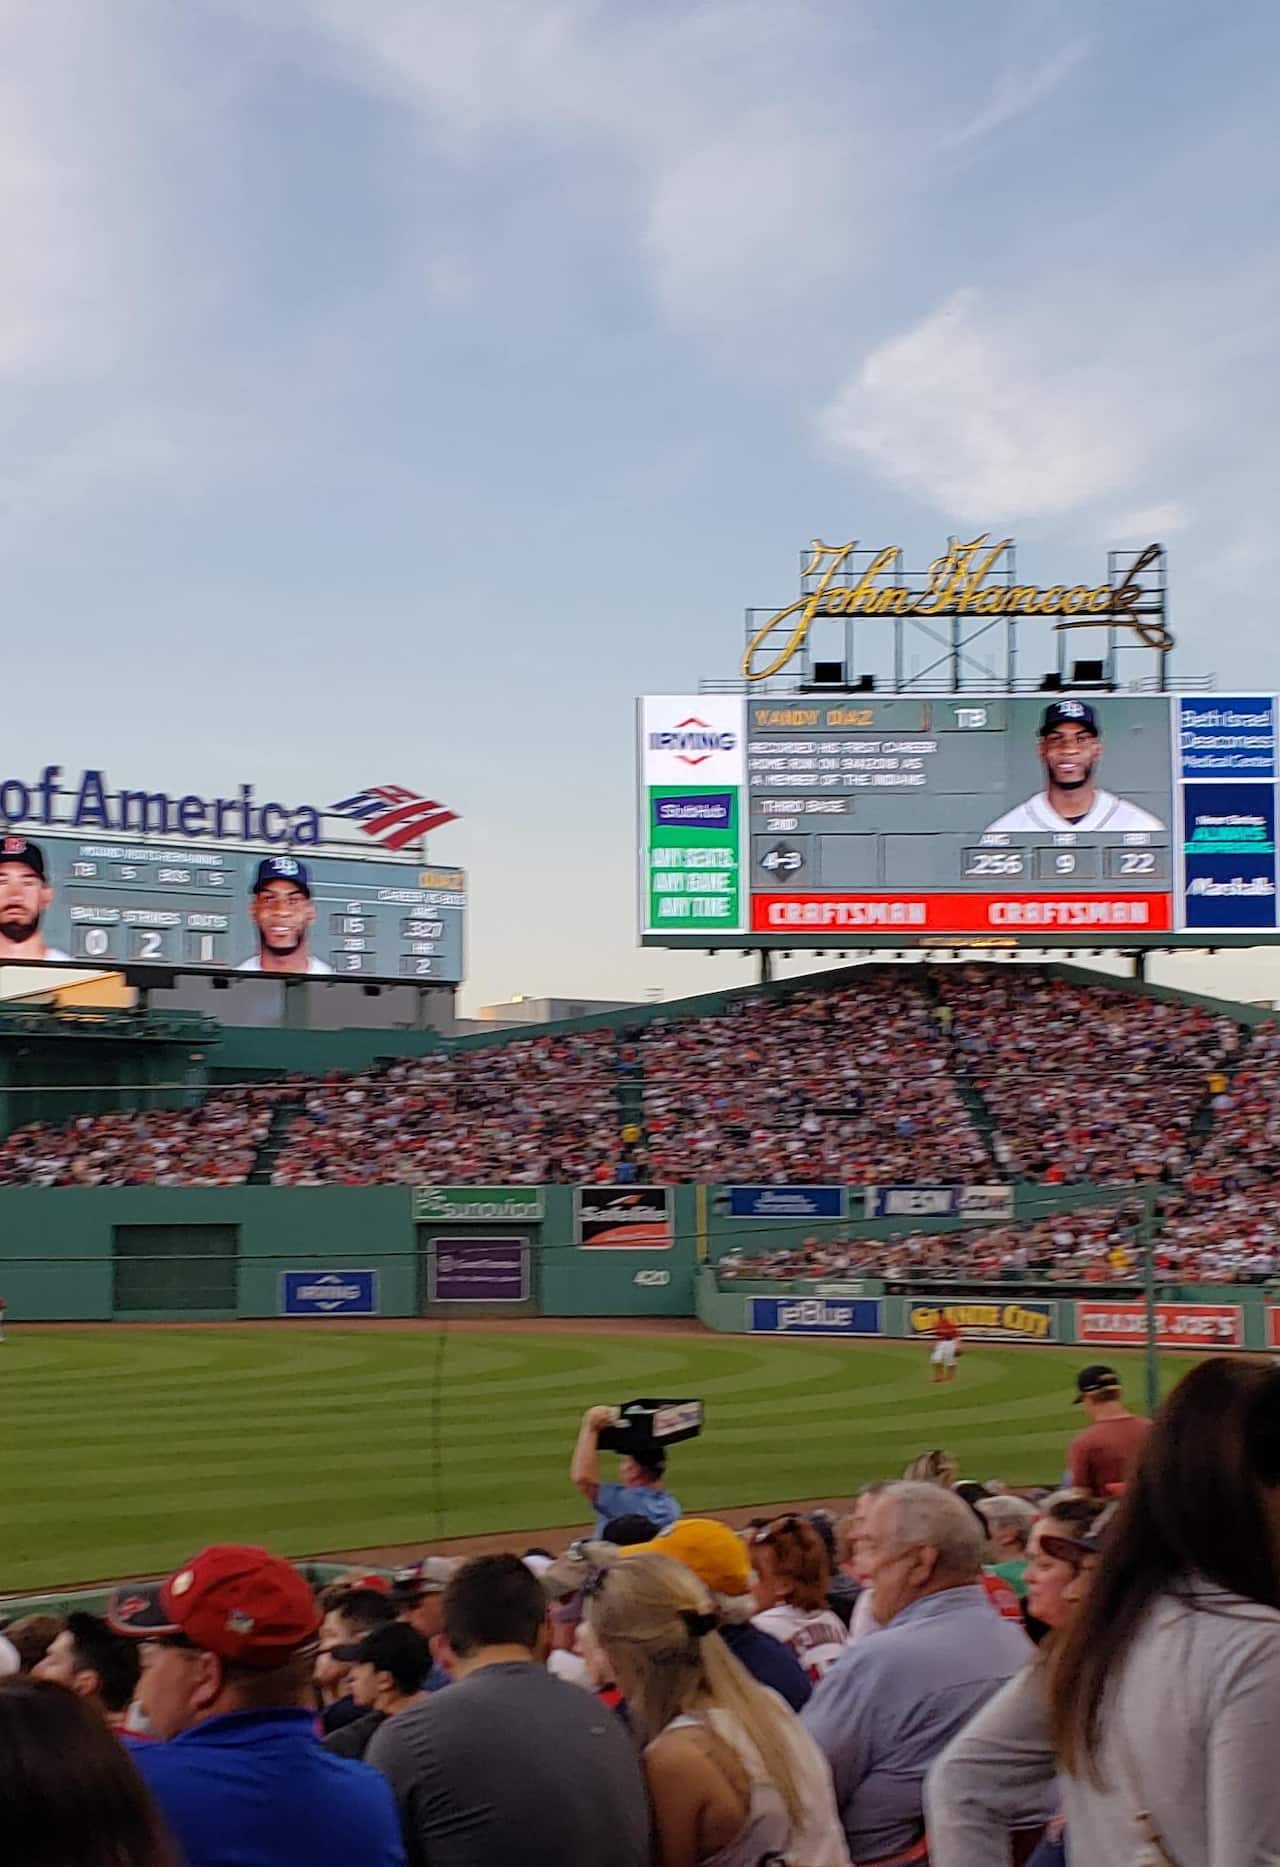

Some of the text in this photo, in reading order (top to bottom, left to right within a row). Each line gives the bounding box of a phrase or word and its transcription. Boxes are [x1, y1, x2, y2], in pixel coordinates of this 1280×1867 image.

[742, 533, 1174, 680] John Hancock
[754, 709, 875, 726] YANDY DIAZ
[954, 708, 987, 728] TB
[648, 731, 736, 751] IRVING
[72, 768, 326, 845] America
[760, 851, 802, 870] 4-3
[1055, 854, 1076, 875] 9
[1120, 853, 1156, 874] 22
[209, 872, 225, 886] 5
[70, 906, 228, 928] BALLS STRIKES OUTS
[768, 902, 926, 925] CRAFTSMAN
[988, 901, 1150, 924] CRAFTSMAN
[85, 929, 214, 961] 0 2 1
[346, 954, 432, 974] 3 2
[634, 1270, 671, 1286] 420
[777, 1300, 855, 1329] jetBlue
[1170, 1314, 1234, 1336] JOE'S
